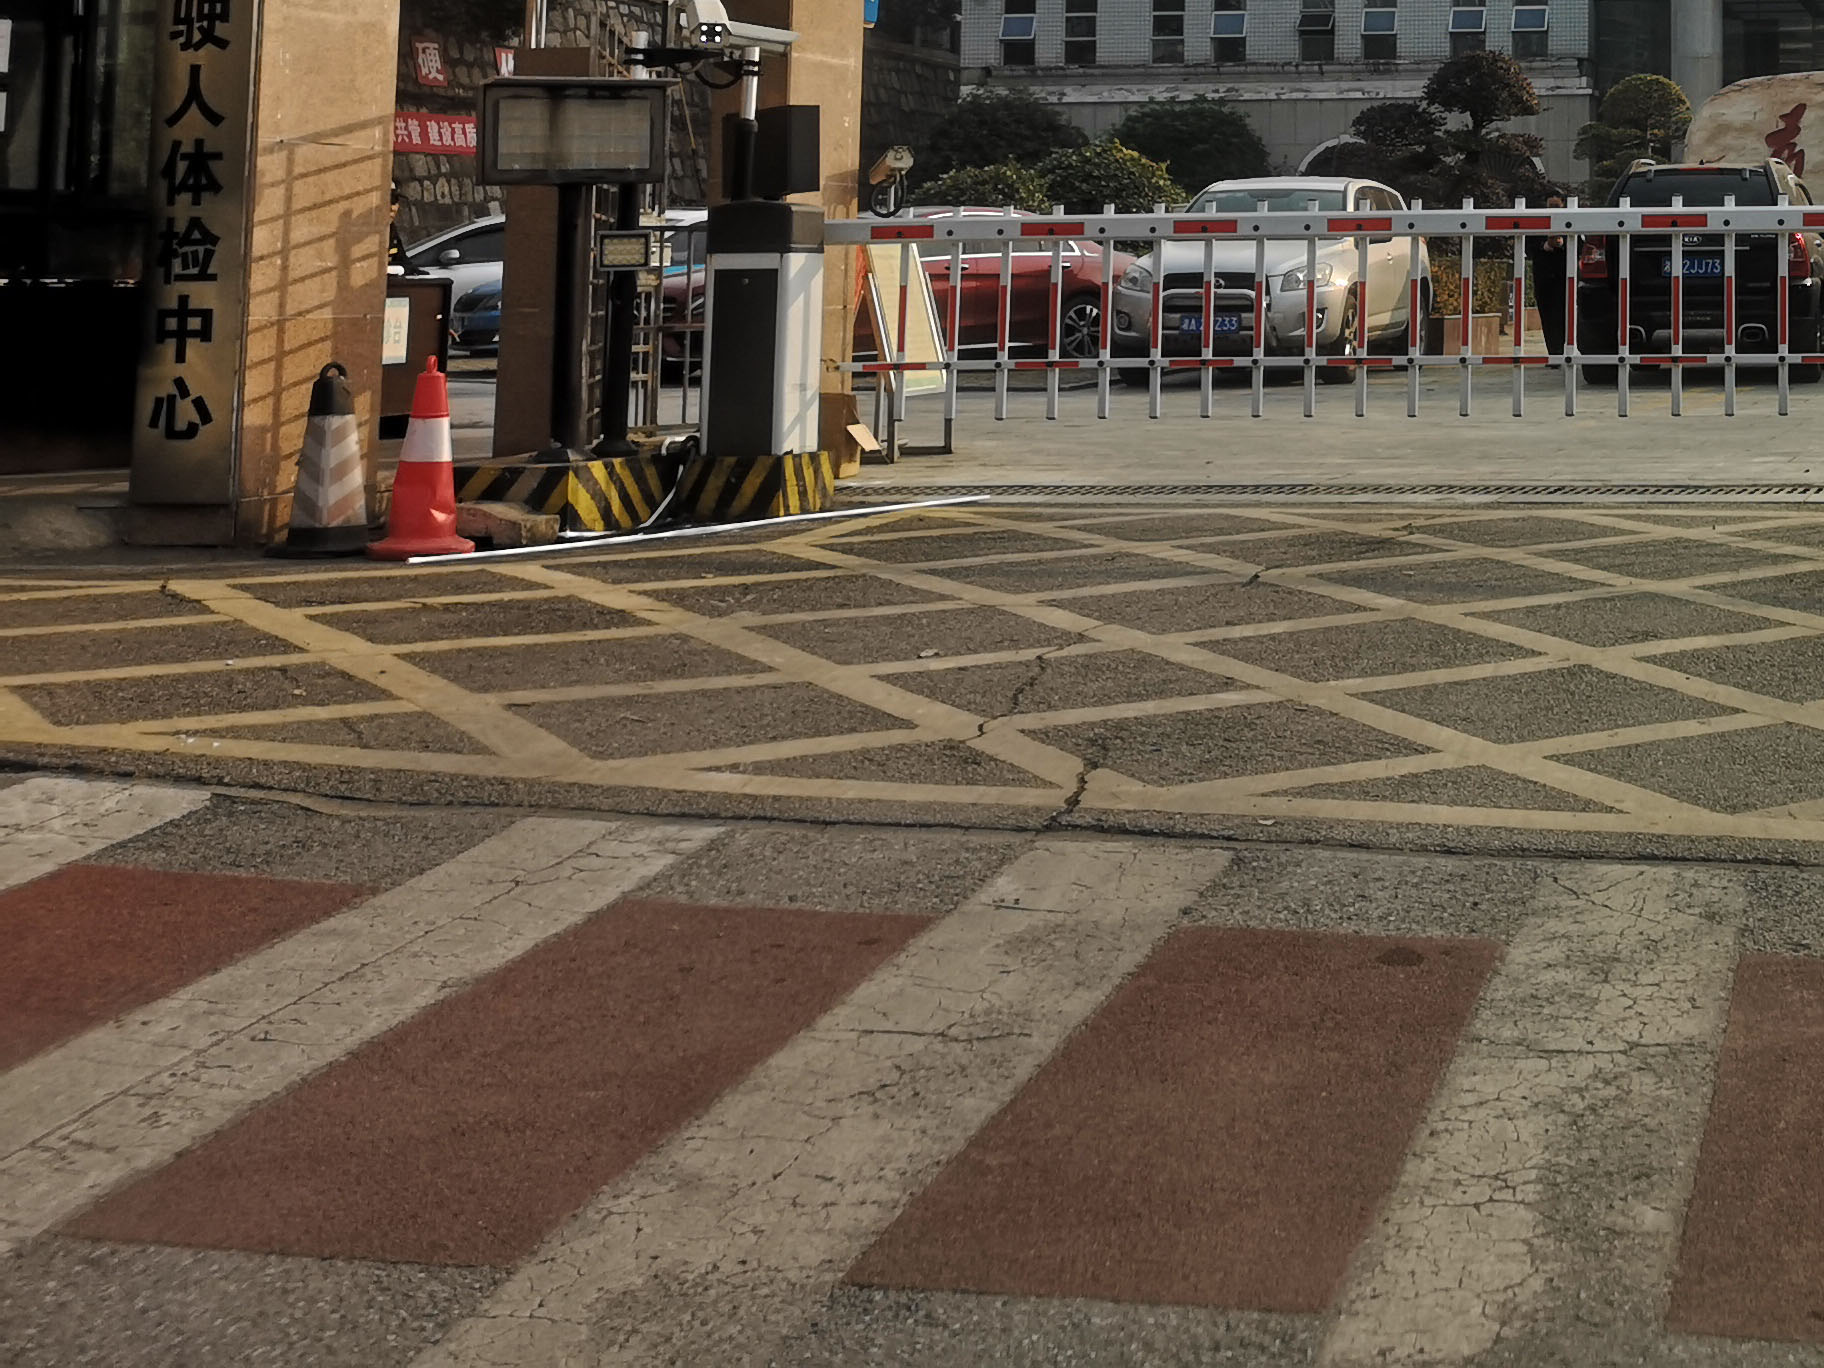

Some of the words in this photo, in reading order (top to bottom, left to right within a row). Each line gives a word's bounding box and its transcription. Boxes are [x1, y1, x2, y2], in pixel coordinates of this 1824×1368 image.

[415, 42, 445, 81] 硬
[393, 117, 422, 145] 共管
[1663, 258, 1721, 274] 湘2JJ73
